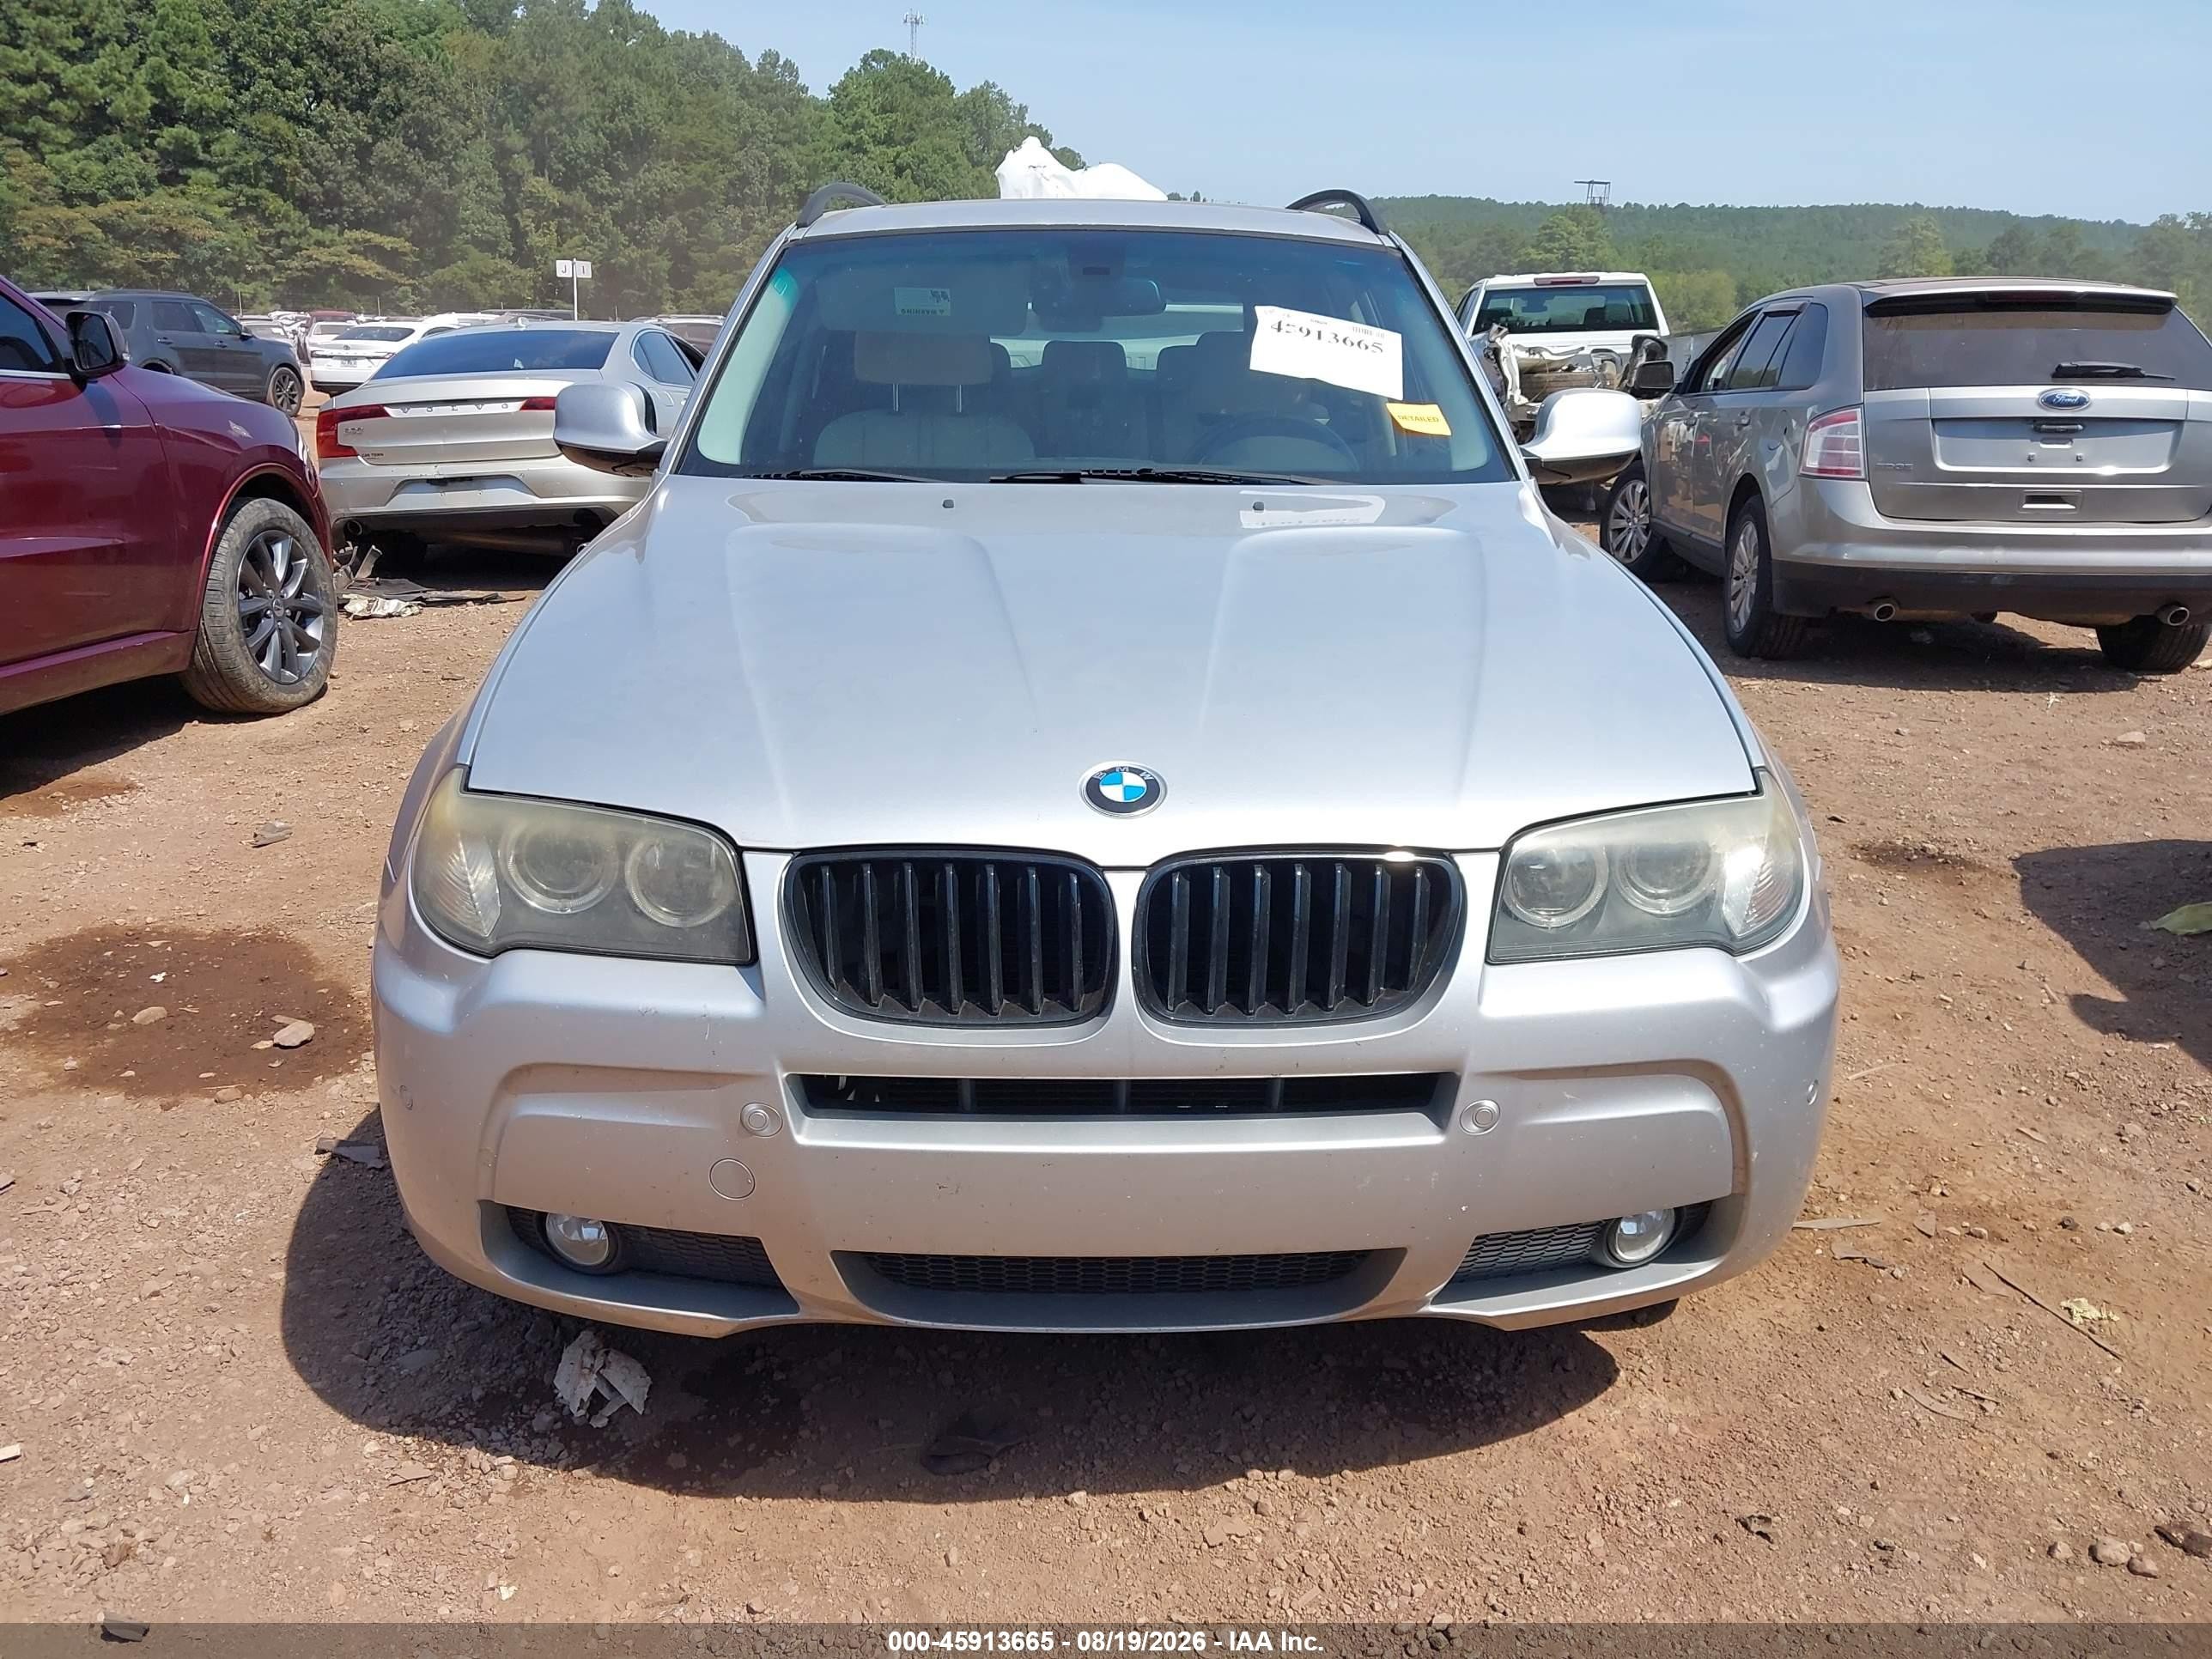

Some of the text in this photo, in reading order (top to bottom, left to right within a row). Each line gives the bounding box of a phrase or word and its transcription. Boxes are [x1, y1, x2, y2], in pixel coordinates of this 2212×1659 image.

[562, 264, 567, 274] J
[2052, 393, 2080, 404] Ford
[398, 402, 508, 414] VOLVO
[1092, 766, 1154, 781] BMW
